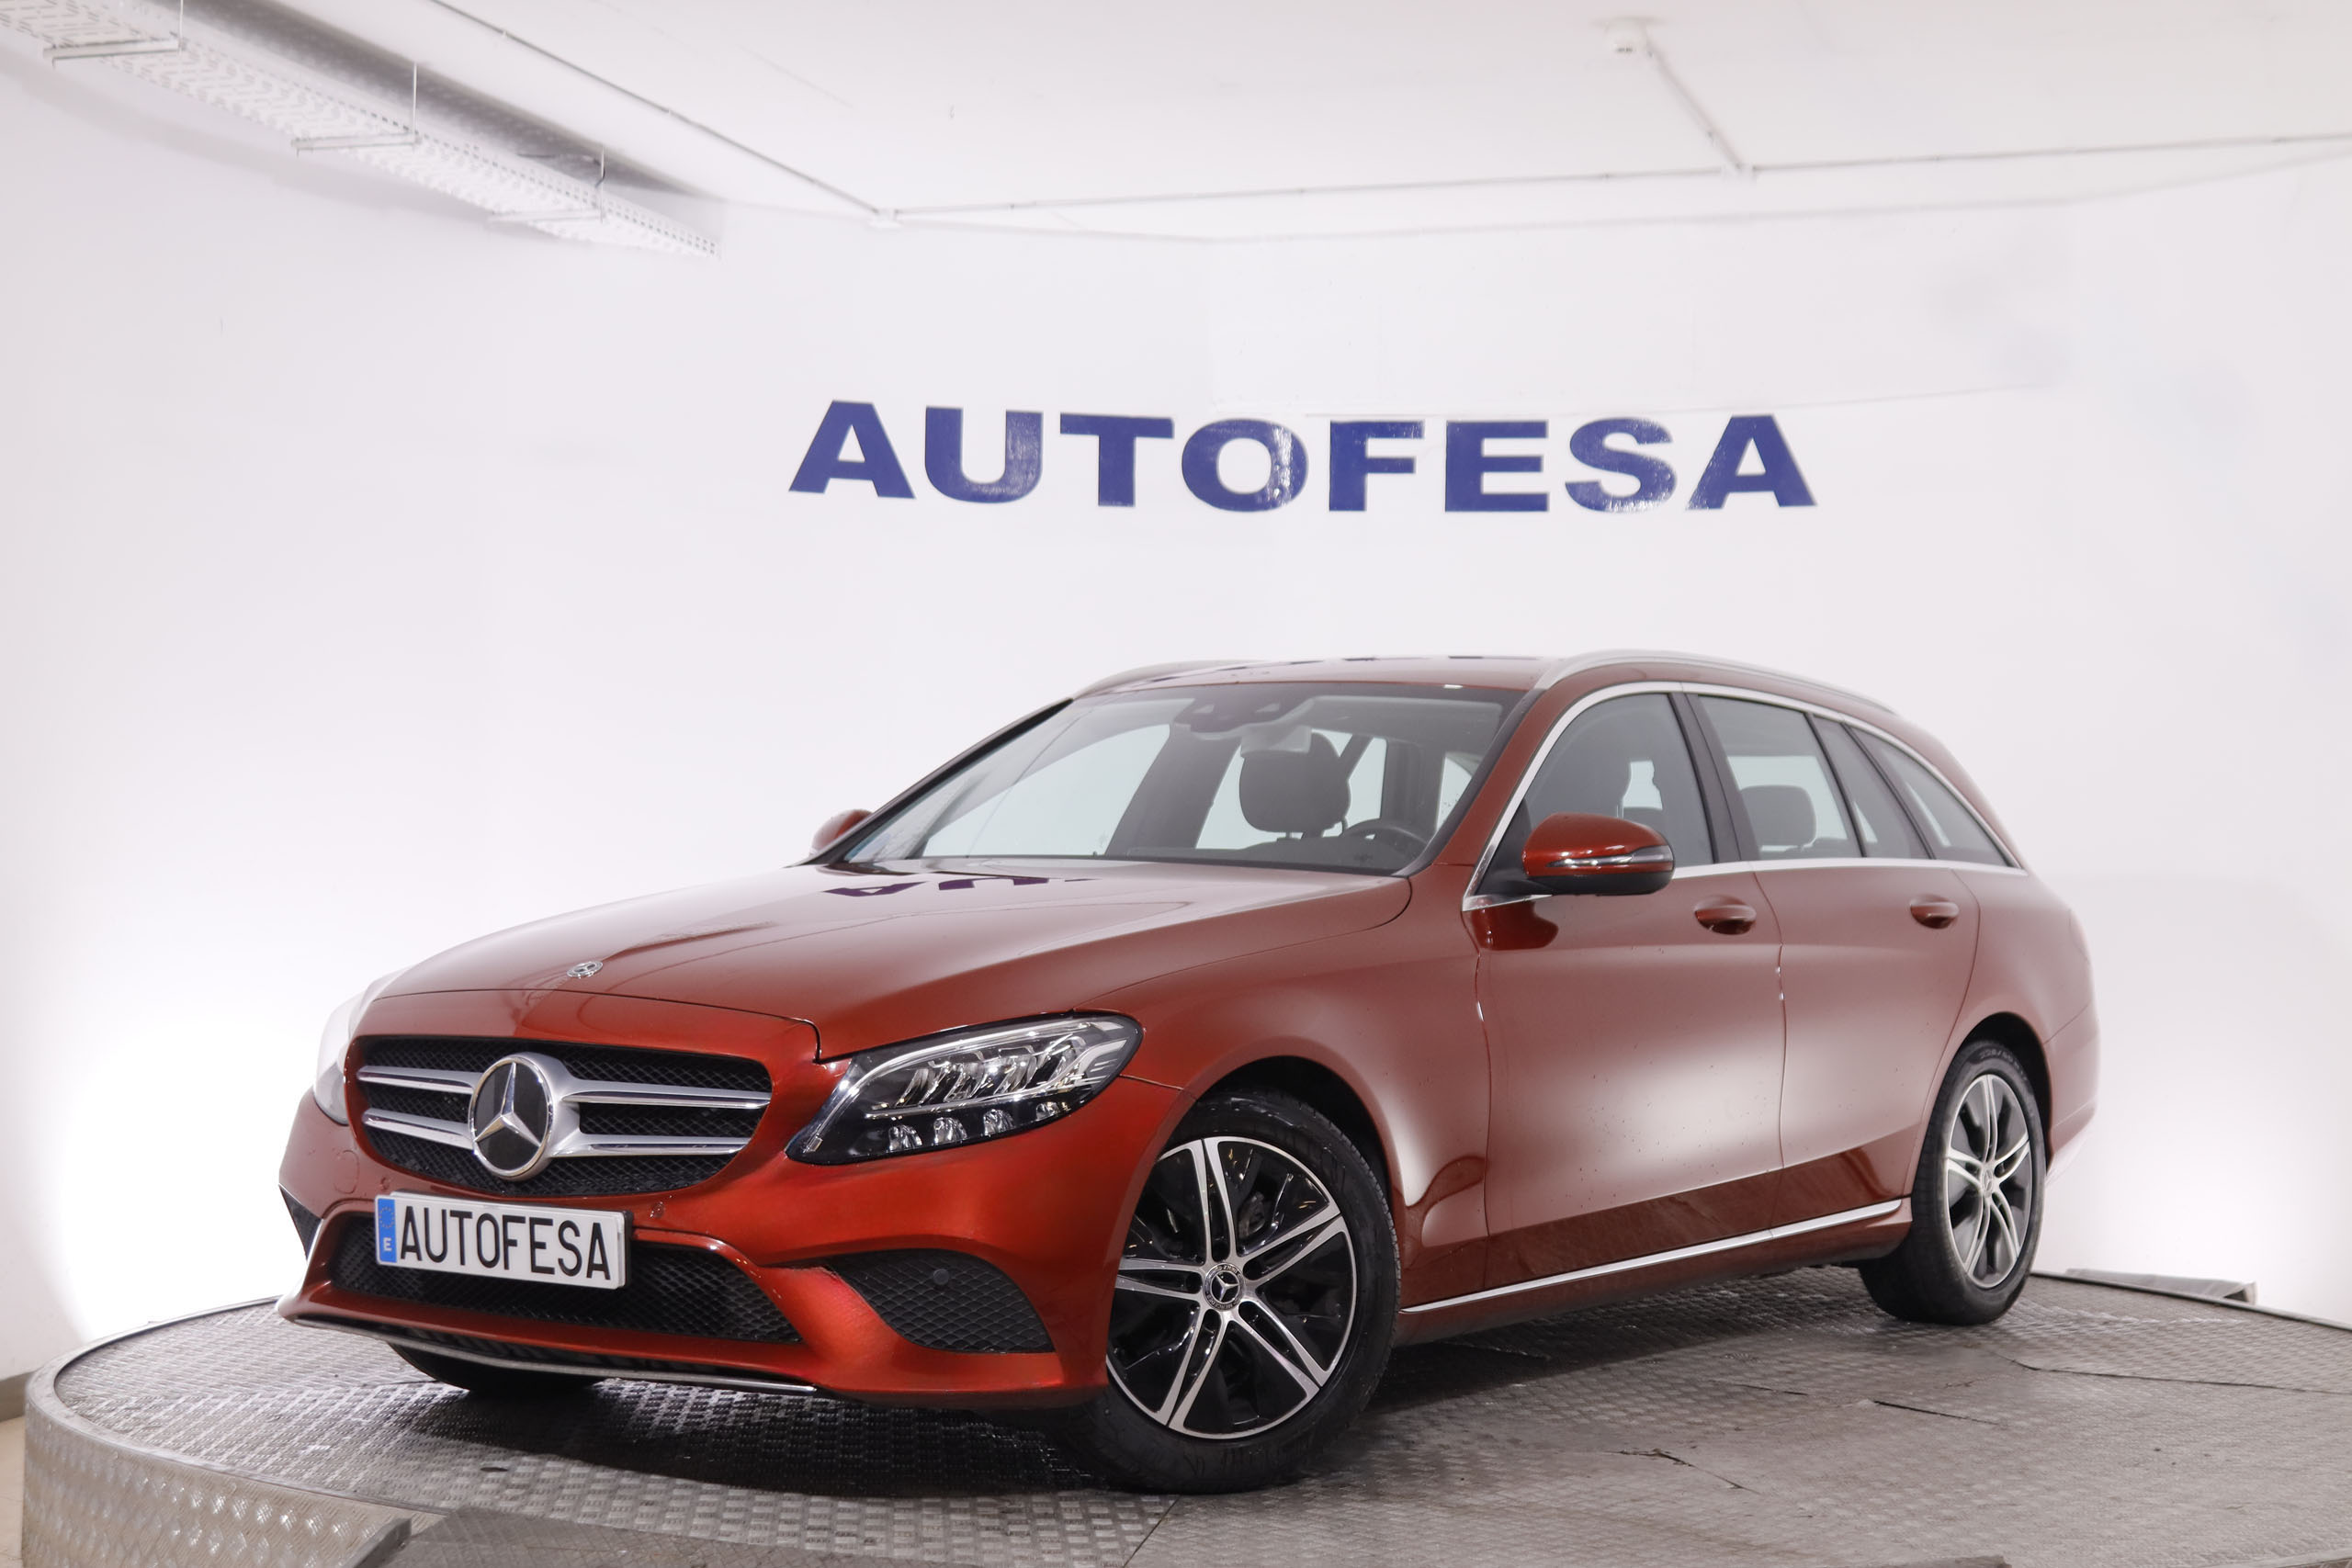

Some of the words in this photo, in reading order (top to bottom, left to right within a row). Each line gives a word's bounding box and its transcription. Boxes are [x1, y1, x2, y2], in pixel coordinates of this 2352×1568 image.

[789, 400, 1815, 512] AUTOFESA
[382, 1237, 392, 1251] E
[400, 1205, 611, 1280] AUTOFESA
